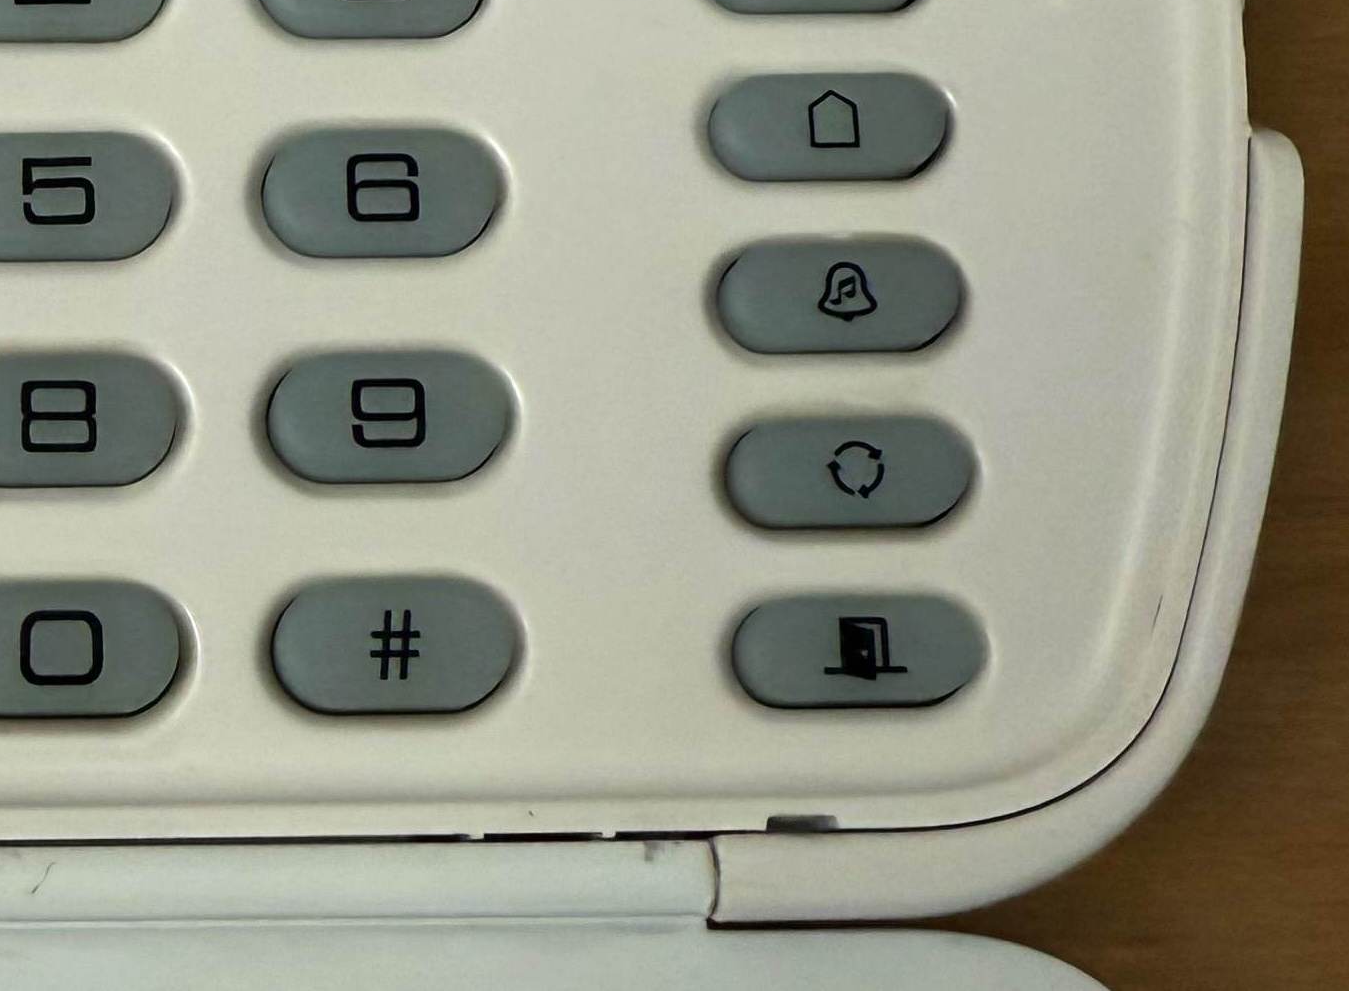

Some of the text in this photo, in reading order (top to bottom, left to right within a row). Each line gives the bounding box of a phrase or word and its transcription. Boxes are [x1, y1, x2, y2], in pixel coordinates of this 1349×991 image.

[21, 156, 96, 226] 5
[345, 152, 421, 224] 6
[19, 379, 98, 454] 8
[350, 377, 428, 451] 9
[369, 608, 422, 681] #
